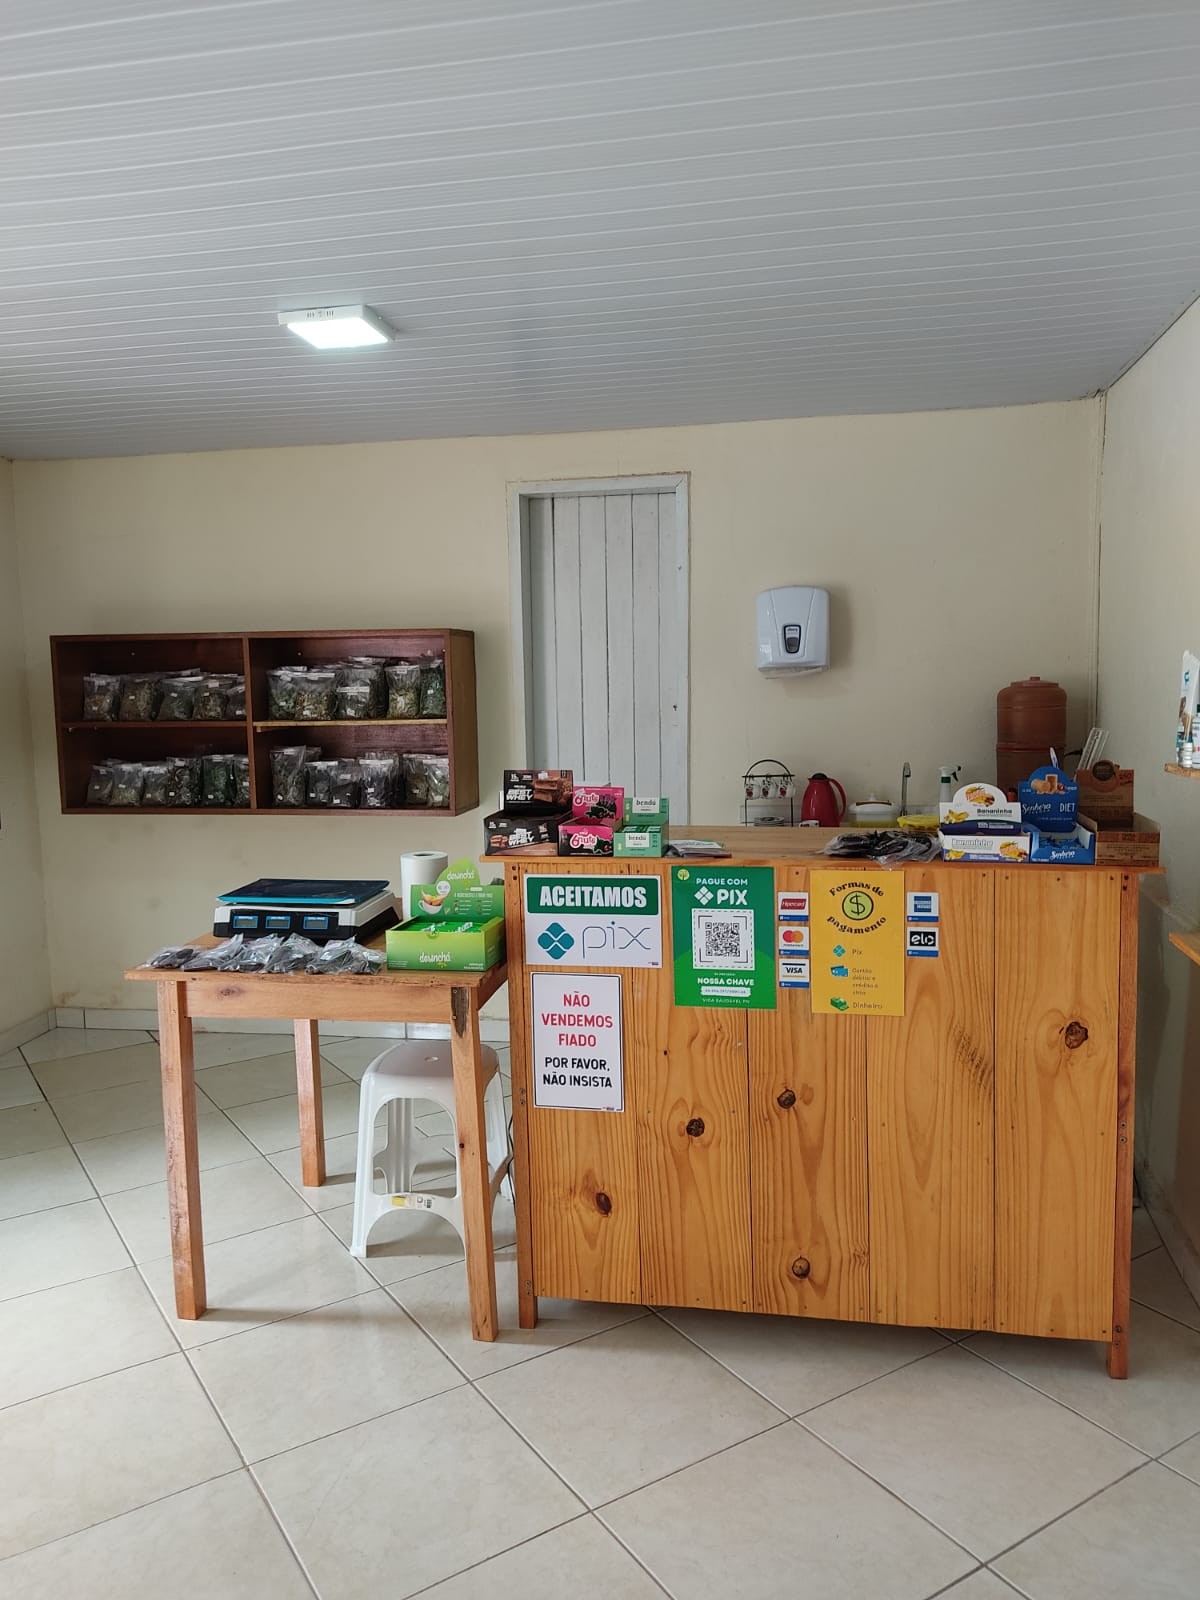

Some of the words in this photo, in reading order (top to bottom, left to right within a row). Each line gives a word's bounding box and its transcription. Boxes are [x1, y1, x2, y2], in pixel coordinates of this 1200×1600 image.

[1059, 802, 1076, 813] DIET
[696, 877, 726, 886] PAGUE
[727, 878, 748, 886] COM
[829, 881, 871, 897] Formas
[872, 885, 885, 897] de
[539, 885, 647, 908] ACEITAMOS
[717, 888, 748, 906] PIX
[826, 916, 887, 935] pagamento
[582, 920, 652, 959] pix
[910, 932, 935, 946] elo
[785, 966, 804, 974] VISA
[697, 977, 725, 985] NOSSA
[726, 978, 754, 986] CHAVE
[562, 990, 591, 1008] NÃO
[541, 1012, 614, 1029] VENDEMOS
[558, 1033, 597, 1048] FIADO
[544, 1056, 568, 1069] POR
[543, 1071, 567, 1086] NÃO
[569, 1075, 613, 1089] INSISTA
